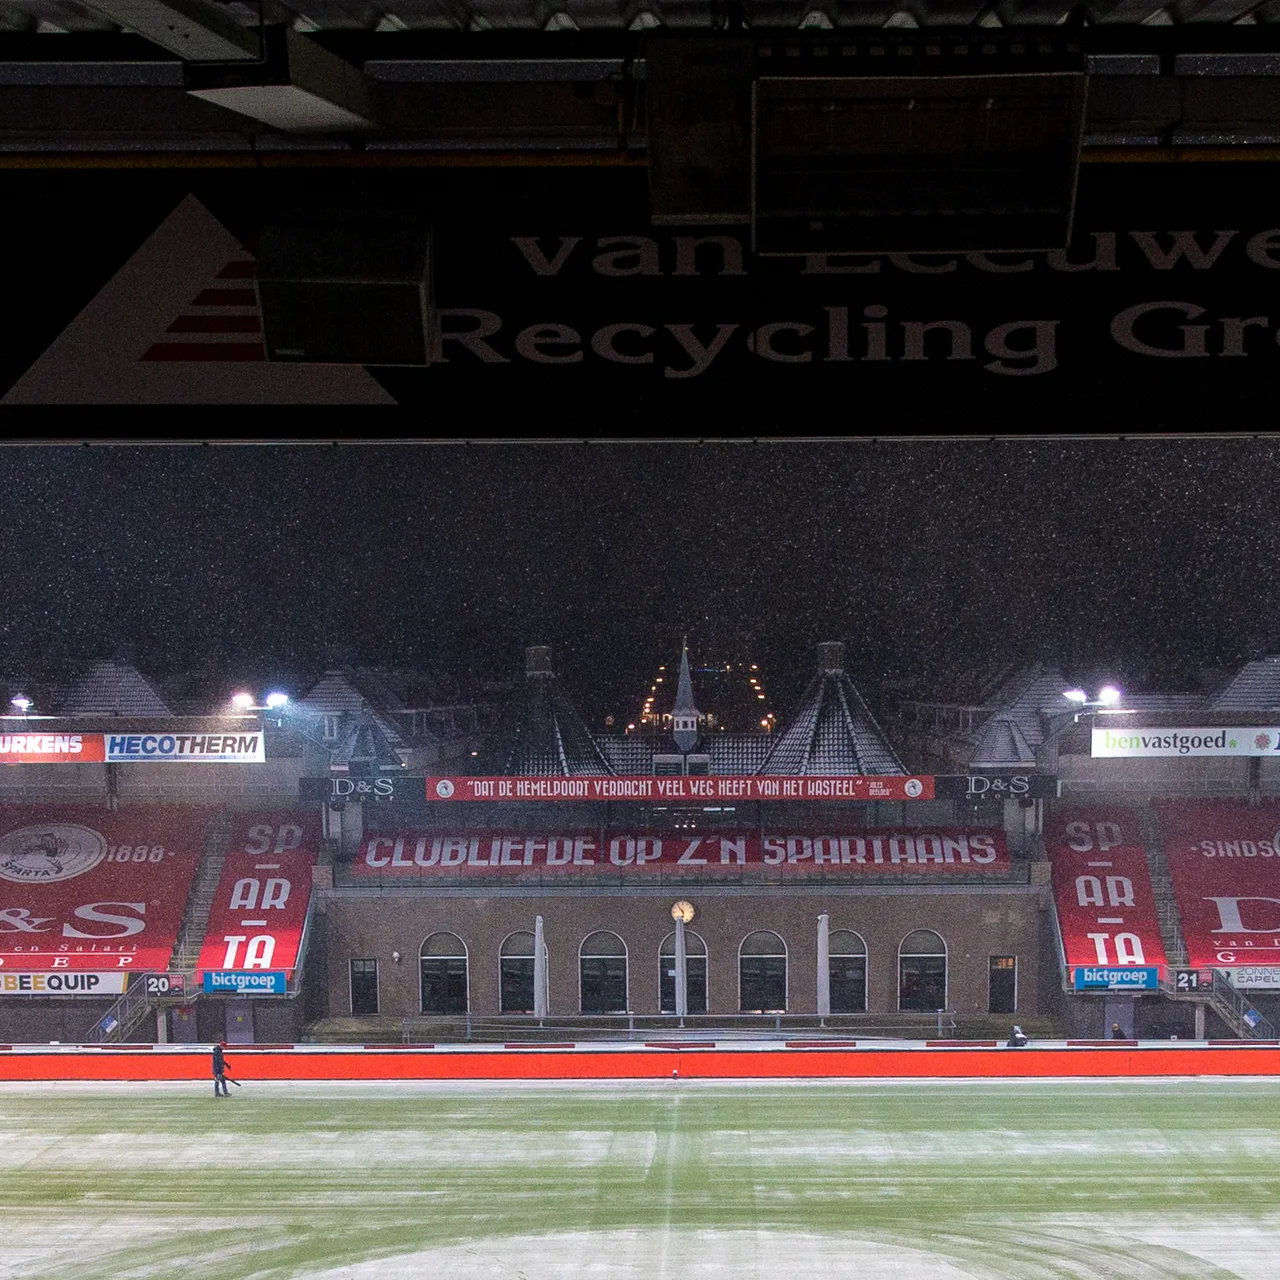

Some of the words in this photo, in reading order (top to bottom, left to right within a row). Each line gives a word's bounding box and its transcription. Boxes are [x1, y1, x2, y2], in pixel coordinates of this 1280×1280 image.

[509, 234, 749, 277] van
[431, 303, 1063, 376] Recycling
[108, 735, 259, 754] HECOTHERM
[1104, 730, 1226, 754] benvastgoed
[331, 777, 394, 796] D&S
[498, 780, 513, 797] DE
[516, 779, 590, 797] HEMELPOORT
[593, 779, 653, 796] VERDACHT
[657, 779, 686, 796] VEEL
[689, 779, 715, 796] WEG
[718, 779, 753, 796] HEEFT
[756, 779, 780, 796] VAN
[783, 779, 804, 796] HET
[965, 776, 1030, 794] D&S
[244, 824, 303, 855] SP
[1065, 820, 1121, 851] SP
[106, 847, 166, 863] 1888
[364, 836, 596, 868] CLUBLIEFDE
[609, 835, 663, 866] OP
[677, 834, 746, 865] Z'N
[764, 834, 998, 865] SPARTAANS
[1200, 840, 1275, 858] SINDS
[0, 861, 51, 877] SPARTA
[229, 877, 291, 909] AR
[1075, 875, 1136, 907] AR
[14, 944, 39, 952] en
[59, 943, 139, 952] Salari
[222, 934, 276, 969] TA
[1087, 932, 1146, 965] TA
[1213, 939, 1253, 947] van
[4, 974, 100, 991] BEEQUIP
[147, 977, 169, 992] 20
[211, 972, 276, 990] bictgroep
[1083, 969, 1148, 985] bictgroep
[1178, 973, 1198, 988] 21
